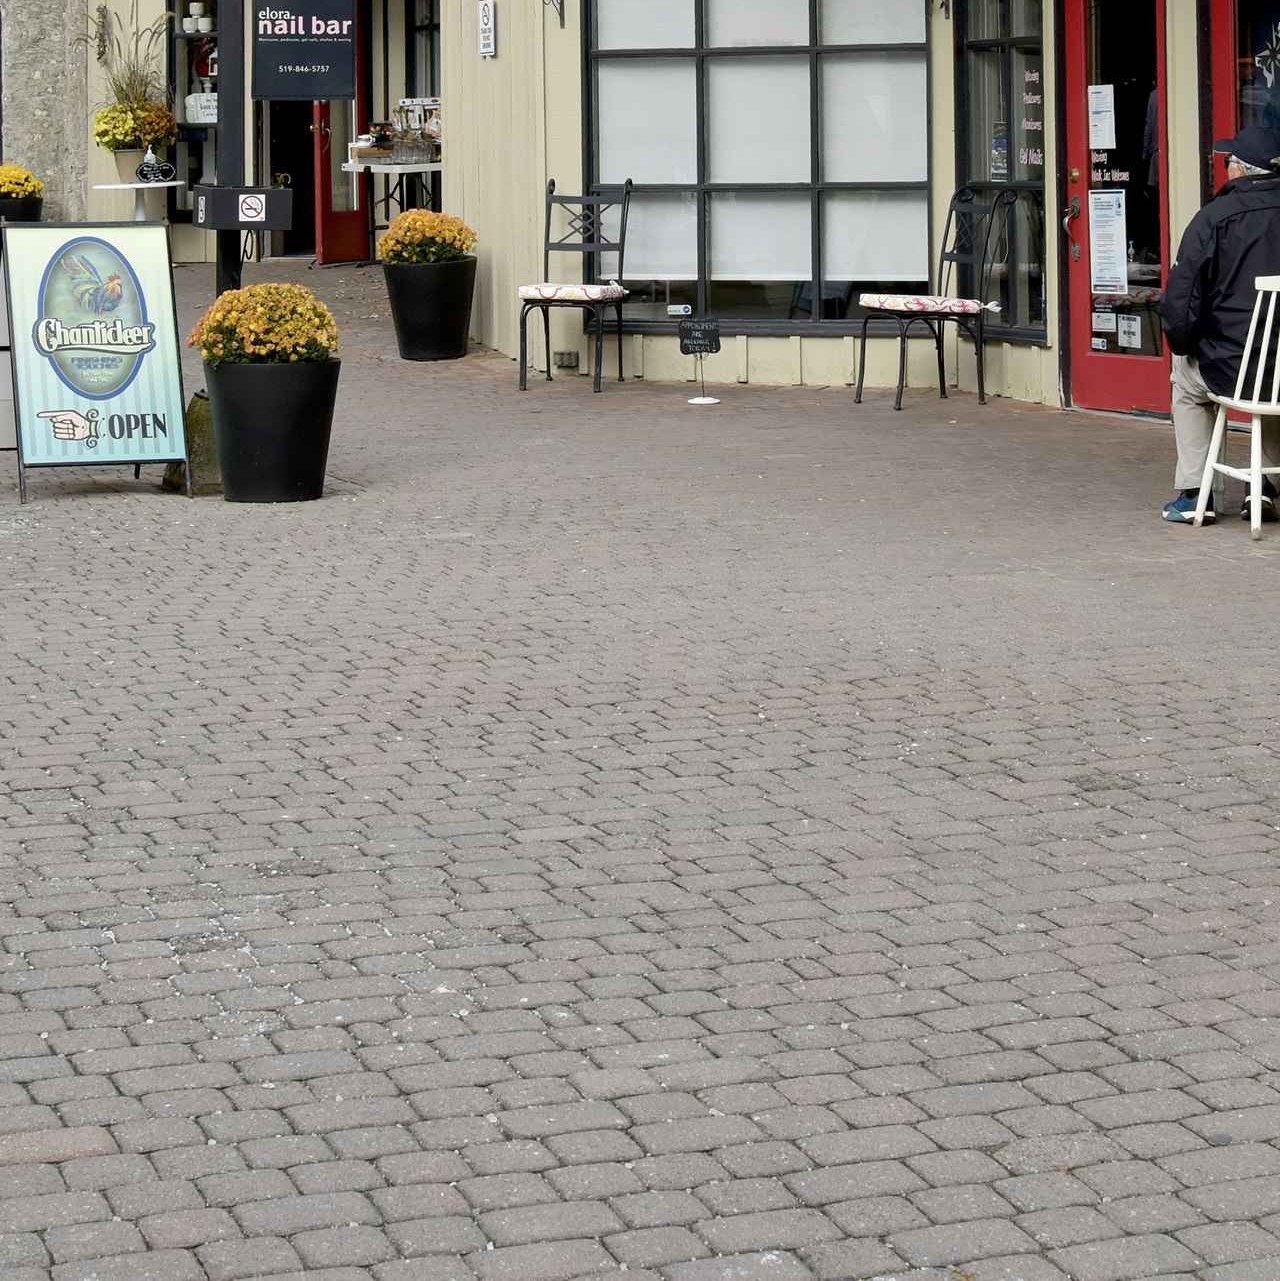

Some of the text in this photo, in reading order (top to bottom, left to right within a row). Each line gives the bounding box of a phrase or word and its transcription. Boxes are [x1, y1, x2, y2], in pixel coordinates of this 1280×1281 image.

[258, 7, 291, 20] elora
[258, 16, 352, 35] nail bar
[279, 65, 330, 73] 519-846-5757
[37, 318, 152, 353] Chanticleer
[108, 413, 167, 440] OPEN
